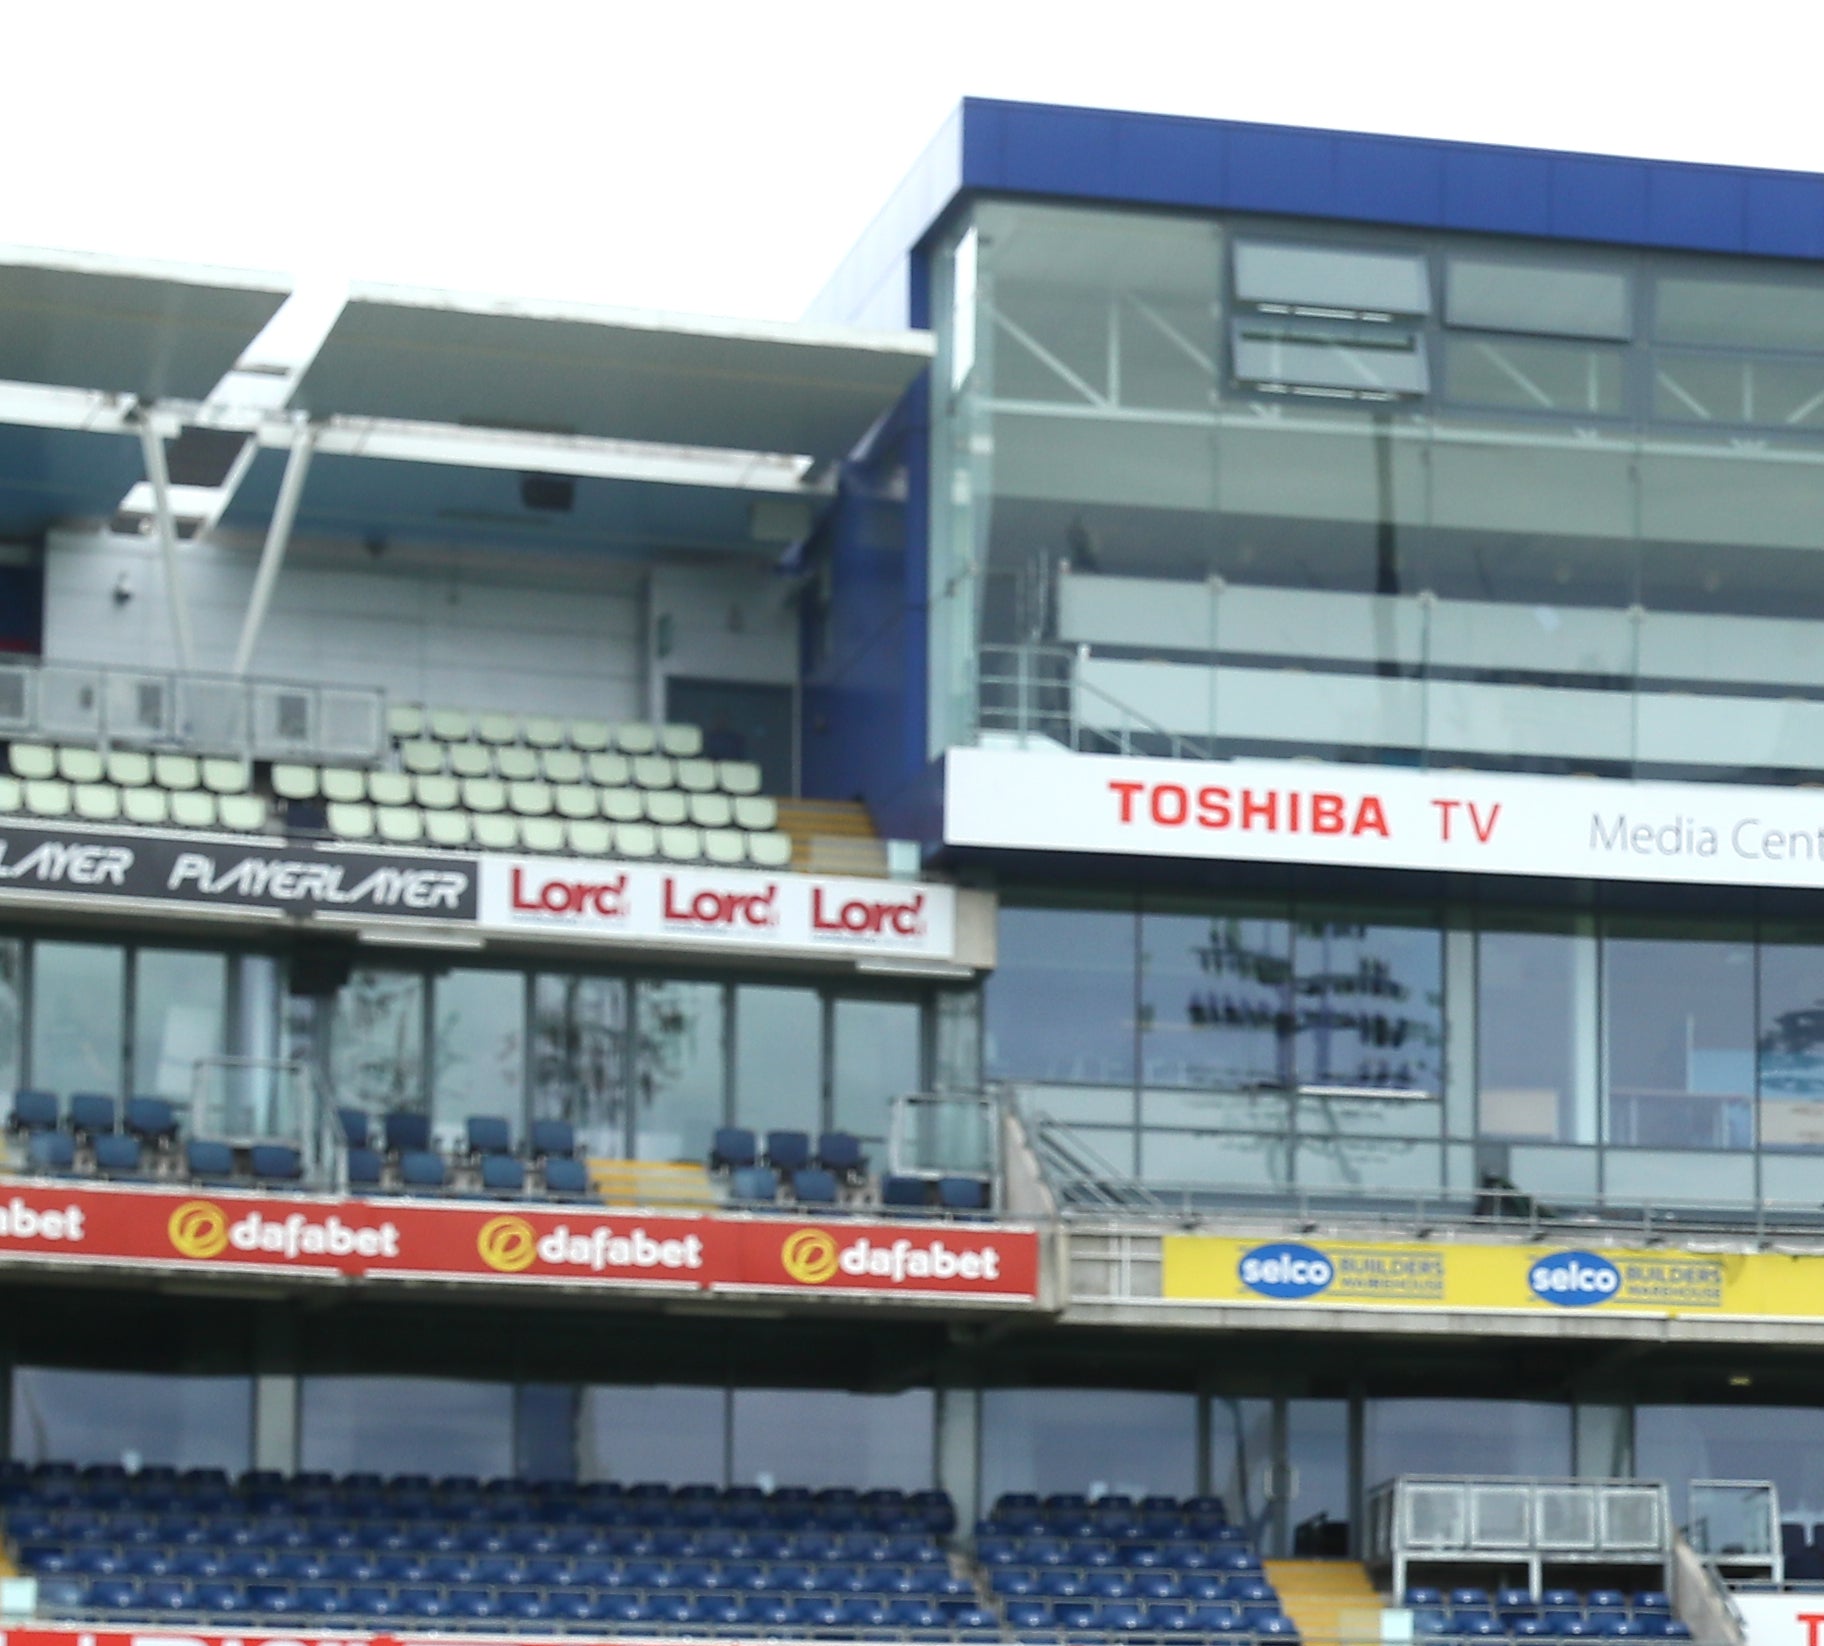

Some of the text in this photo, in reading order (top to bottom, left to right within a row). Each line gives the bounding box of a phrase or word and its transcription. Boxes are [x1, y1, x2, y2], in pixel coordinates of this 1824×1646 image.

[1110, 781, 1389, 837] TOSHIBA
[1432, 799, 1501, 843] TV
[1590, 813, 1718, 857] Media
[229, 1212, 399, 1257] dafabet
[537, 1226, 702, 1270] dafabet
[839, 1239, 999, 1281] dafabet
[1239, 1253, 1331, 1285] selco
[1530, 1264, 1619, 1295] selco
